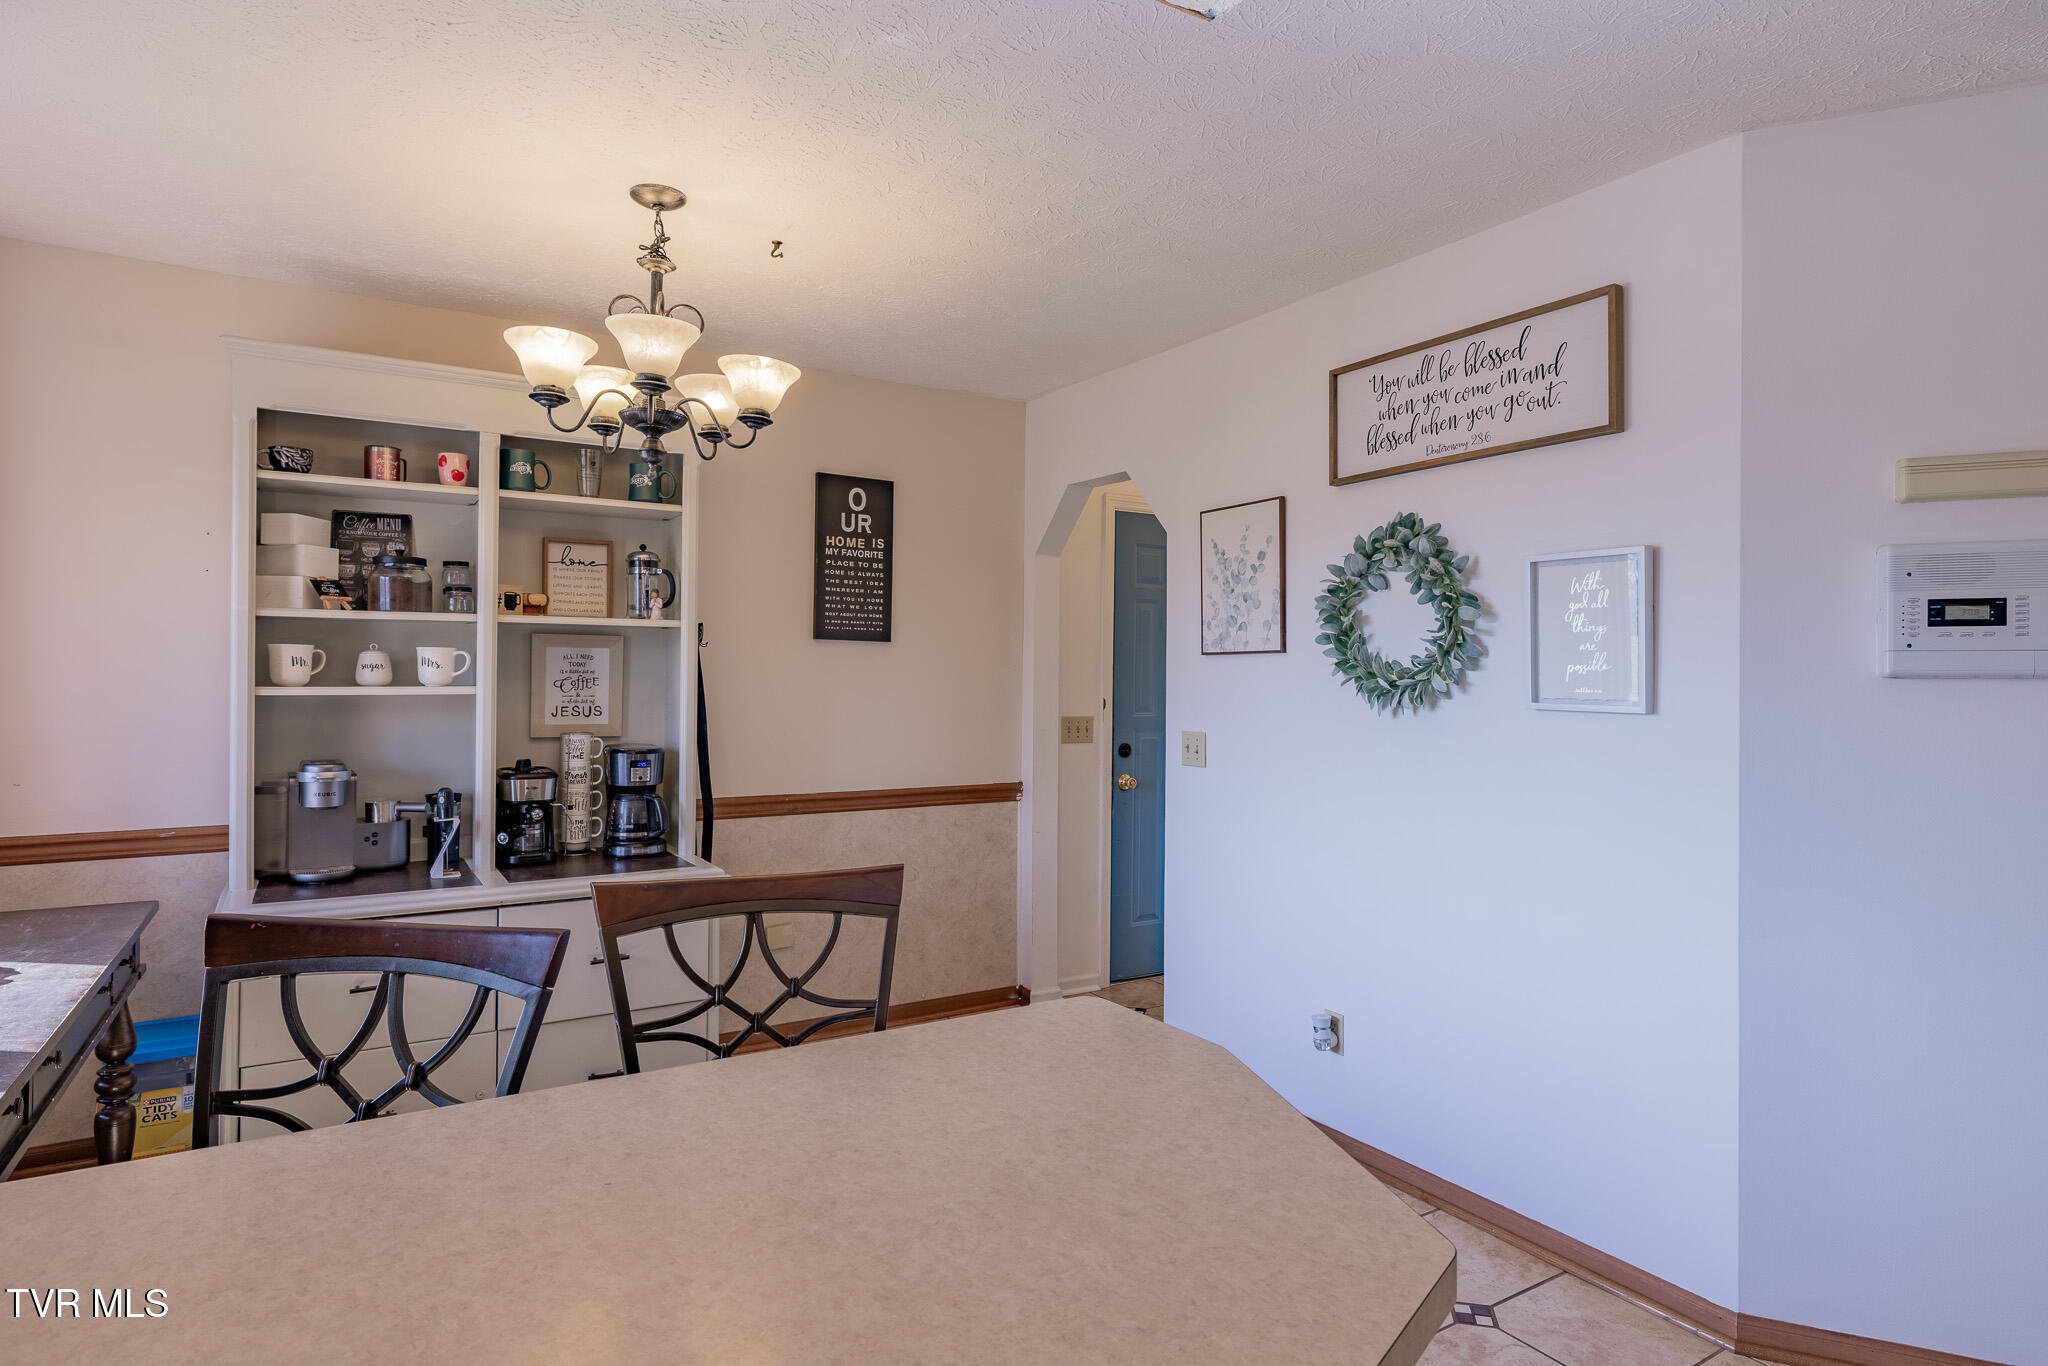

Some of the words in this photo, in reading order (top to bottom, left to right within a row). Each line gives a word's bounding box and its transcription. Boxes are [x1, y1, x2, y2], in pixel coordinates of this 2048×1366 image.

[1368, 374, 1406, 402] You
[1407, 354, 1435, 388] will
[1440, 350, 1460, 383] be
[1464, 325, 1532, 378] blessed
[1378, 391, 1420, 422] when
[1422, 387, 1454, 416] you
[1454, 381, 1498, 404] come
[1522, 342, 1568, 382] and
[1367, 412, 1420, 456] blessed
[1421, 406, 1464, 436] when
[1466, 402, 1501, 432] you
[1504, 390, 1531, 422] go
[1526, 380, 1568, 412] out.
[1426, 440, 1470, 456] Deuteronomy
[848, 488, 866, 511] O
[343, 515, 376, 534] Coffee
[377, 518, 401, 531] MENU
[841, 512, 872, 534] UR
[826, 536, 865, 548] HOME
[872, 538, 884, 548] IS
[548, 546, 608, 566] home
[826, 548, 839, 556] MY
[842, 548, 884, 559] FAVORITE
[1570, 570, 1605, 594] With
[1565, 591, 1589, 622] god
[1590, 588, 1609, 608] all
[1571, 613, 1607, 641] things
[1580, 642, 1598, 650] are
[291, 656, 309, 667] Mr.
[360, 662, 384, 672] sugar
[421, 656, 443, 669] Mrs.
[1566, 652, 1613, 682] possible
[551, 705, 602, 718] JESUS
[143, 1103, 176, 1114] TIDY
[150, 1096, 176, 1104] PURINA
[141, 1111, 177, 1123] CATS
